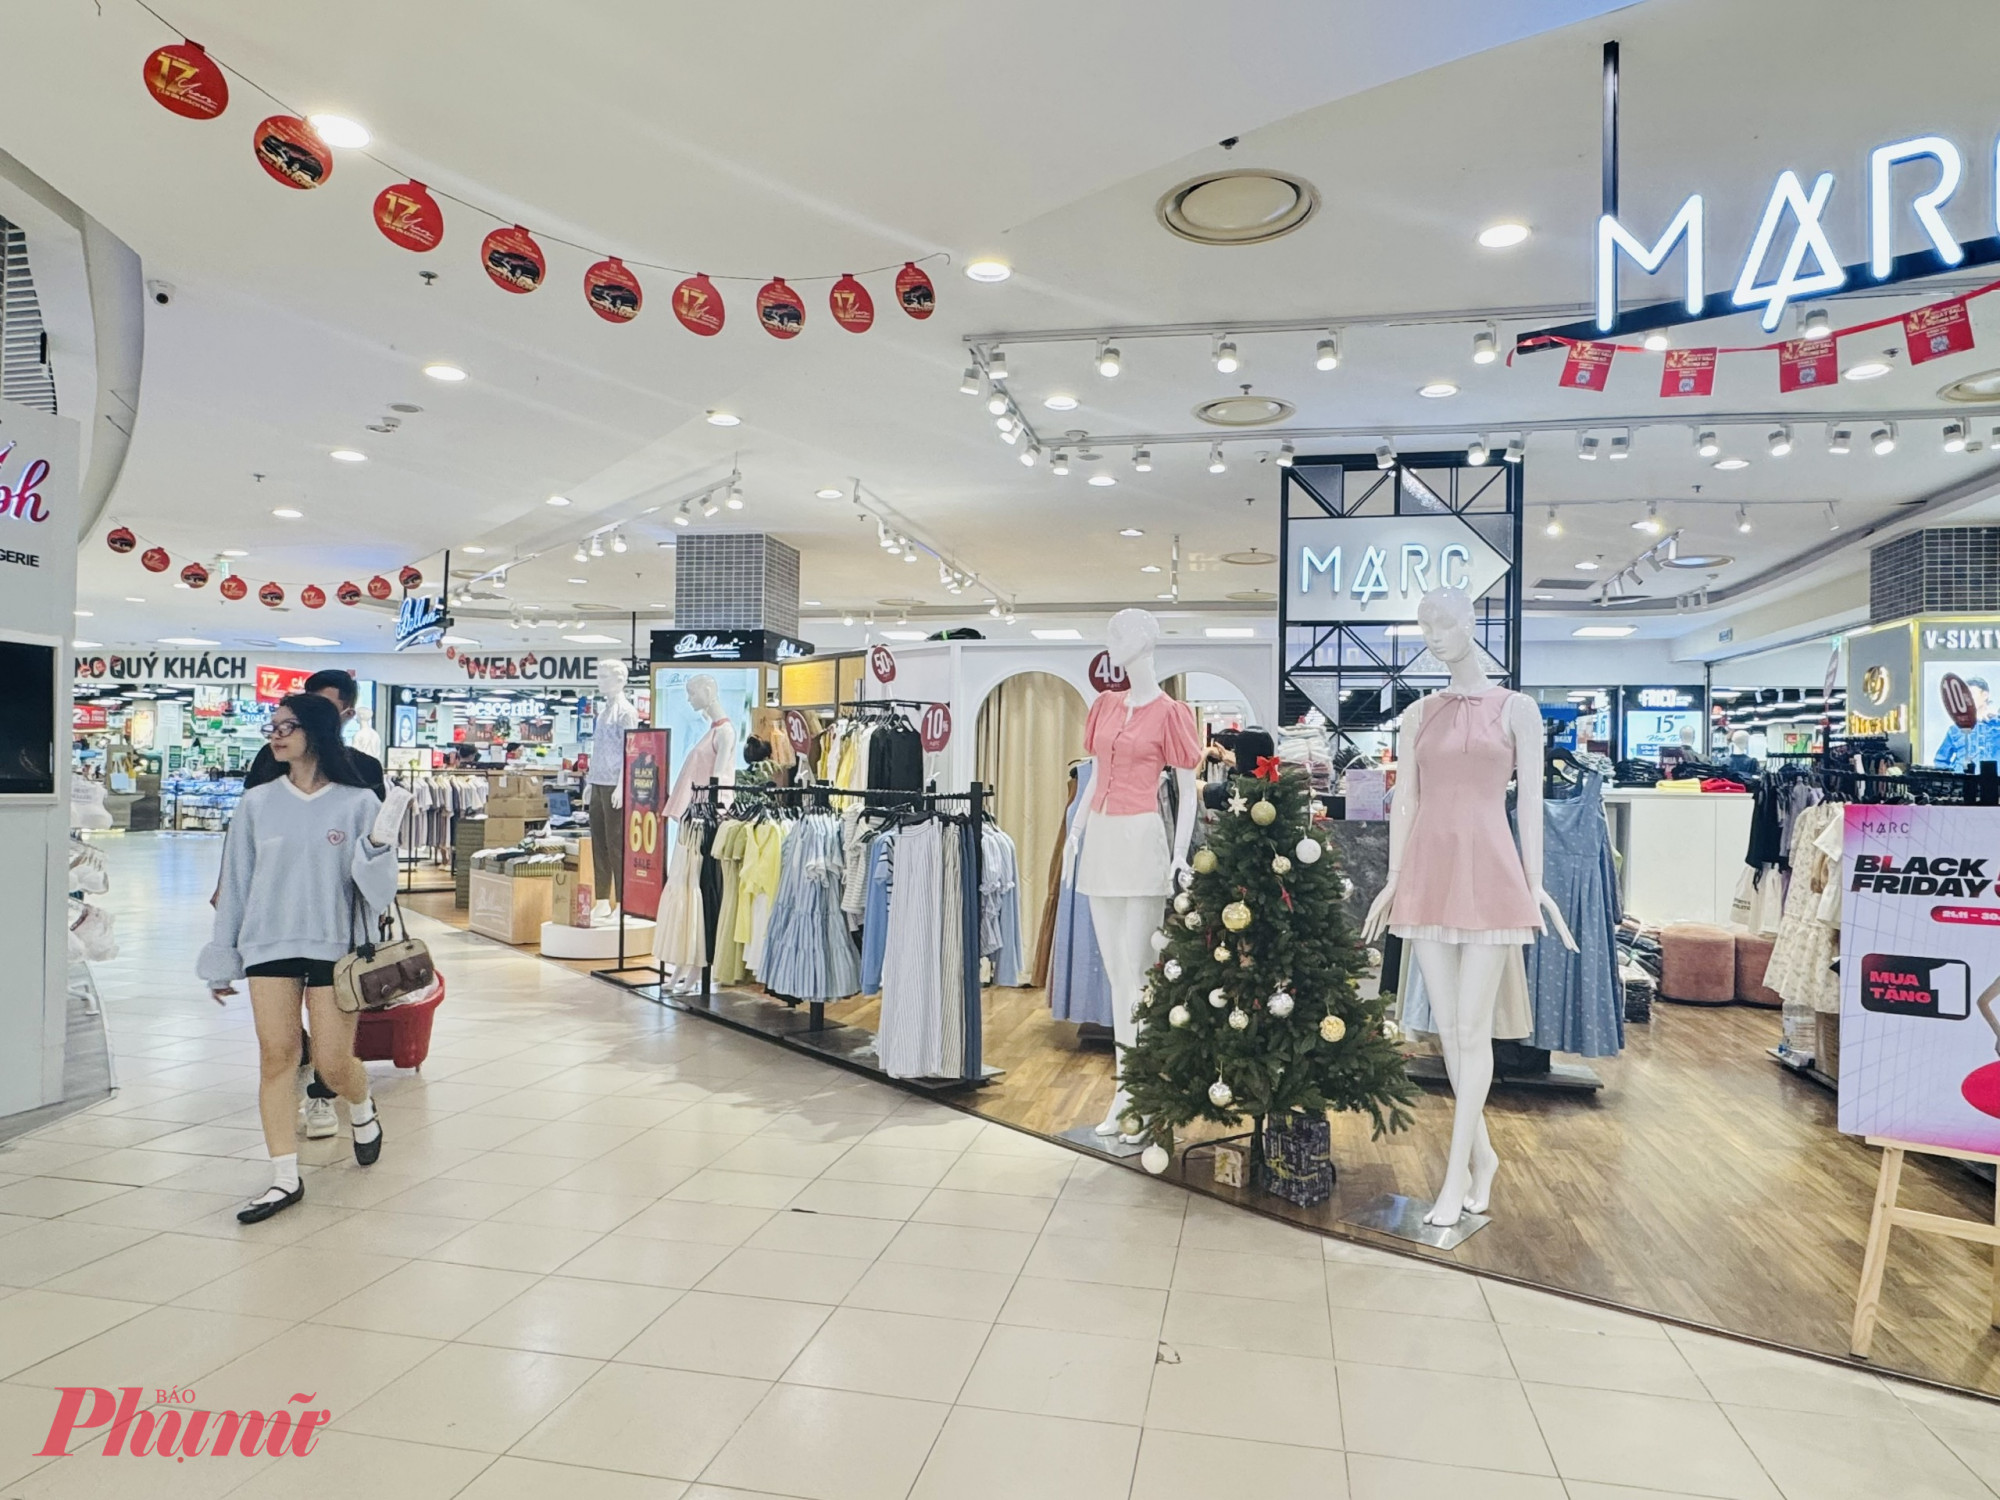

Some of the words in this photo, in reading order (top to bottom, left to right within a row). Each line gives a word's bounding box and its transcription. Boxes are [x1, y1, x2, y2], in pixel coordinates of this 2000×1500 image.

[154, 54, 199, 93] 17
[382, 193, 422, 229] 17
[1598, 136, 2000, 331] MAR
[679, 288, 708, 318] 17
[833, 292, 855, 319] 17
[1302, 544, 1470, 603] MARC
[110, 652, 159, 679] QUÝ
[164, 652, 247, 679] KHÁCH
[465, 657, 598, 680] WELCOME
[465, 699, 546, 717] aescentic
[1656, 715, 1675, 734] 15
[634, 768, 654, 778] BLACK
[634, 778, 654, 789] FRIDAY
[1862, 822, 1910, 835] MARC
[1854, 855, 1989, 878] BLACK
[1851, 874, 1993, 898] FRIDAY
[1870, 970, 1919, 987] MUA
[1869, 986, 1932, 1004] TẶNG
